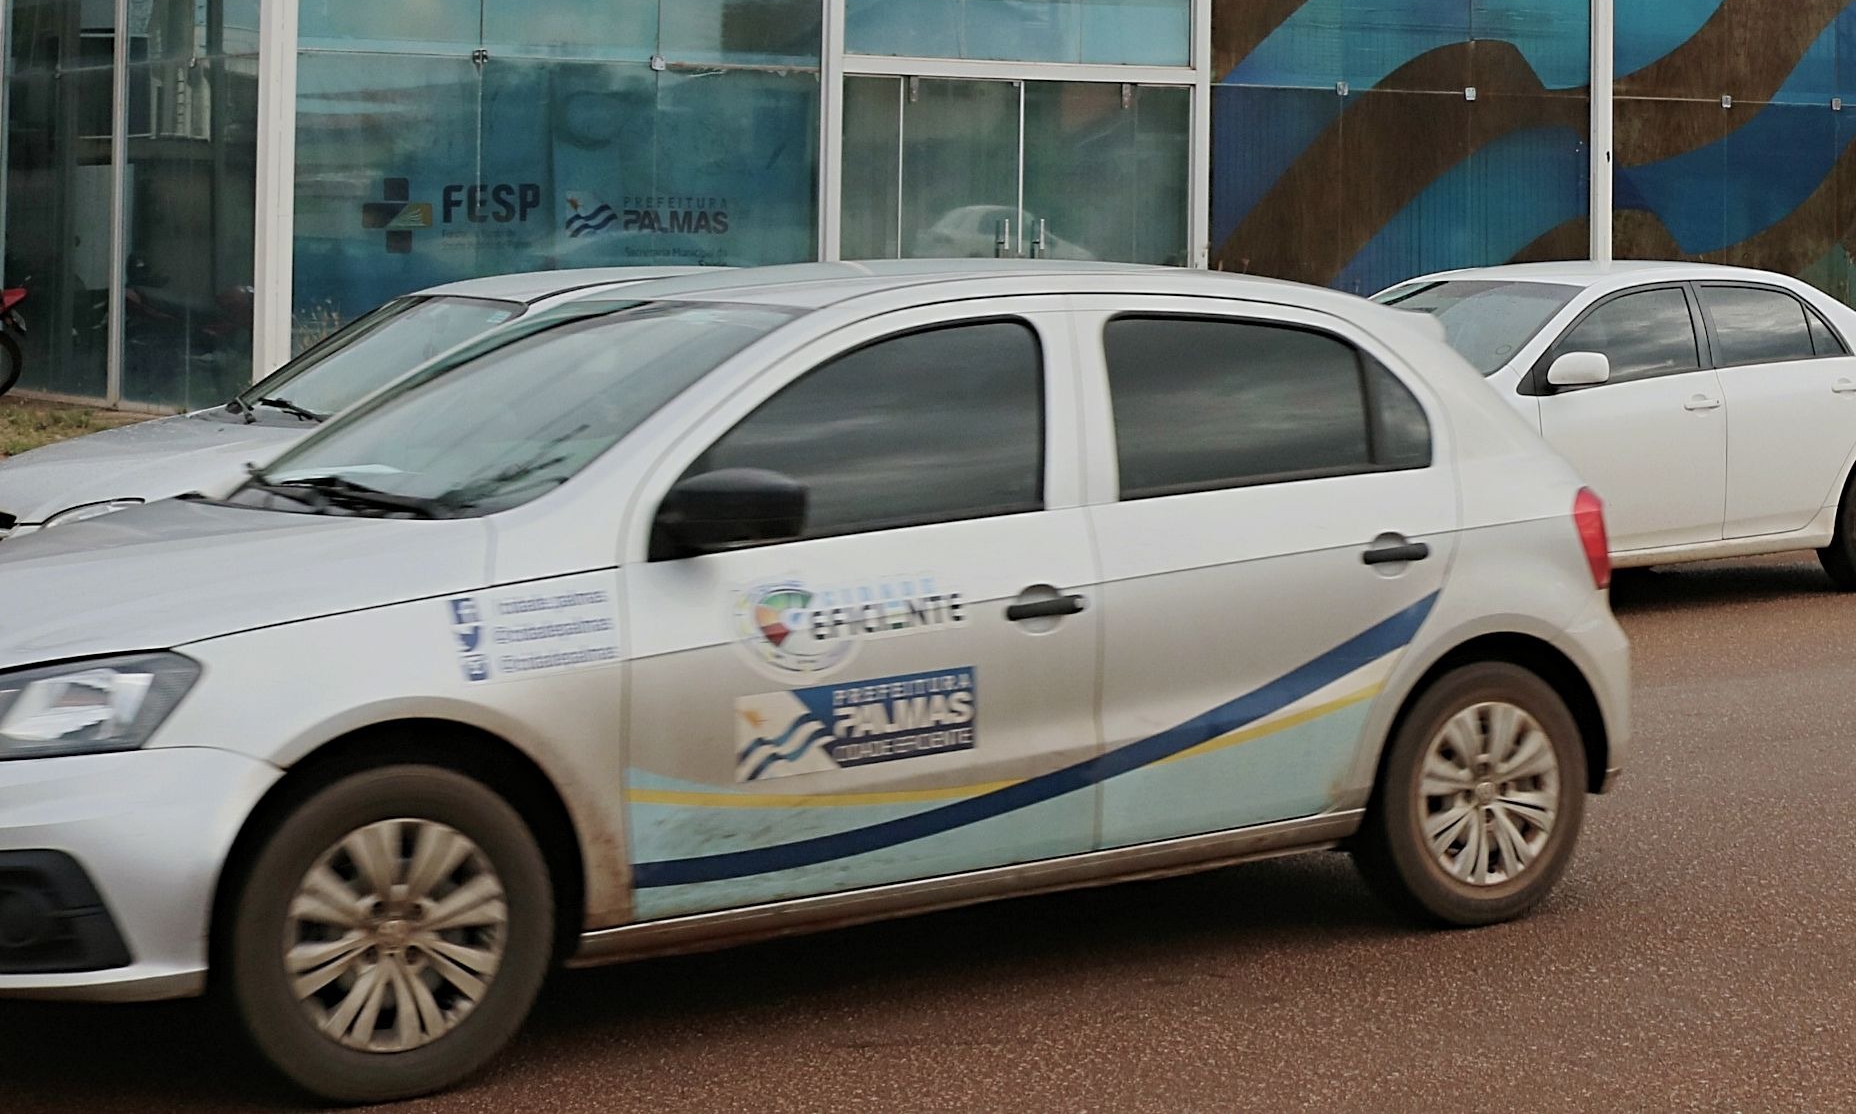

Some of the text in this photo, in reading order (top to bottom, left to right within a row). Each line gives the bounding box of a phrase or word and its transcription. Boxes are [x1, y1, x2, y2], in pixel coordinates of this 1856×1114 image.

[442, 183, 541, 224] FESP
[623, 196, 728, 209] PREFEITURA
[623, 209, 729, 235] PALMAS
[832, 673, 974, 706] PREFEITURA
[832, 691, 977, 740] PALMAS
